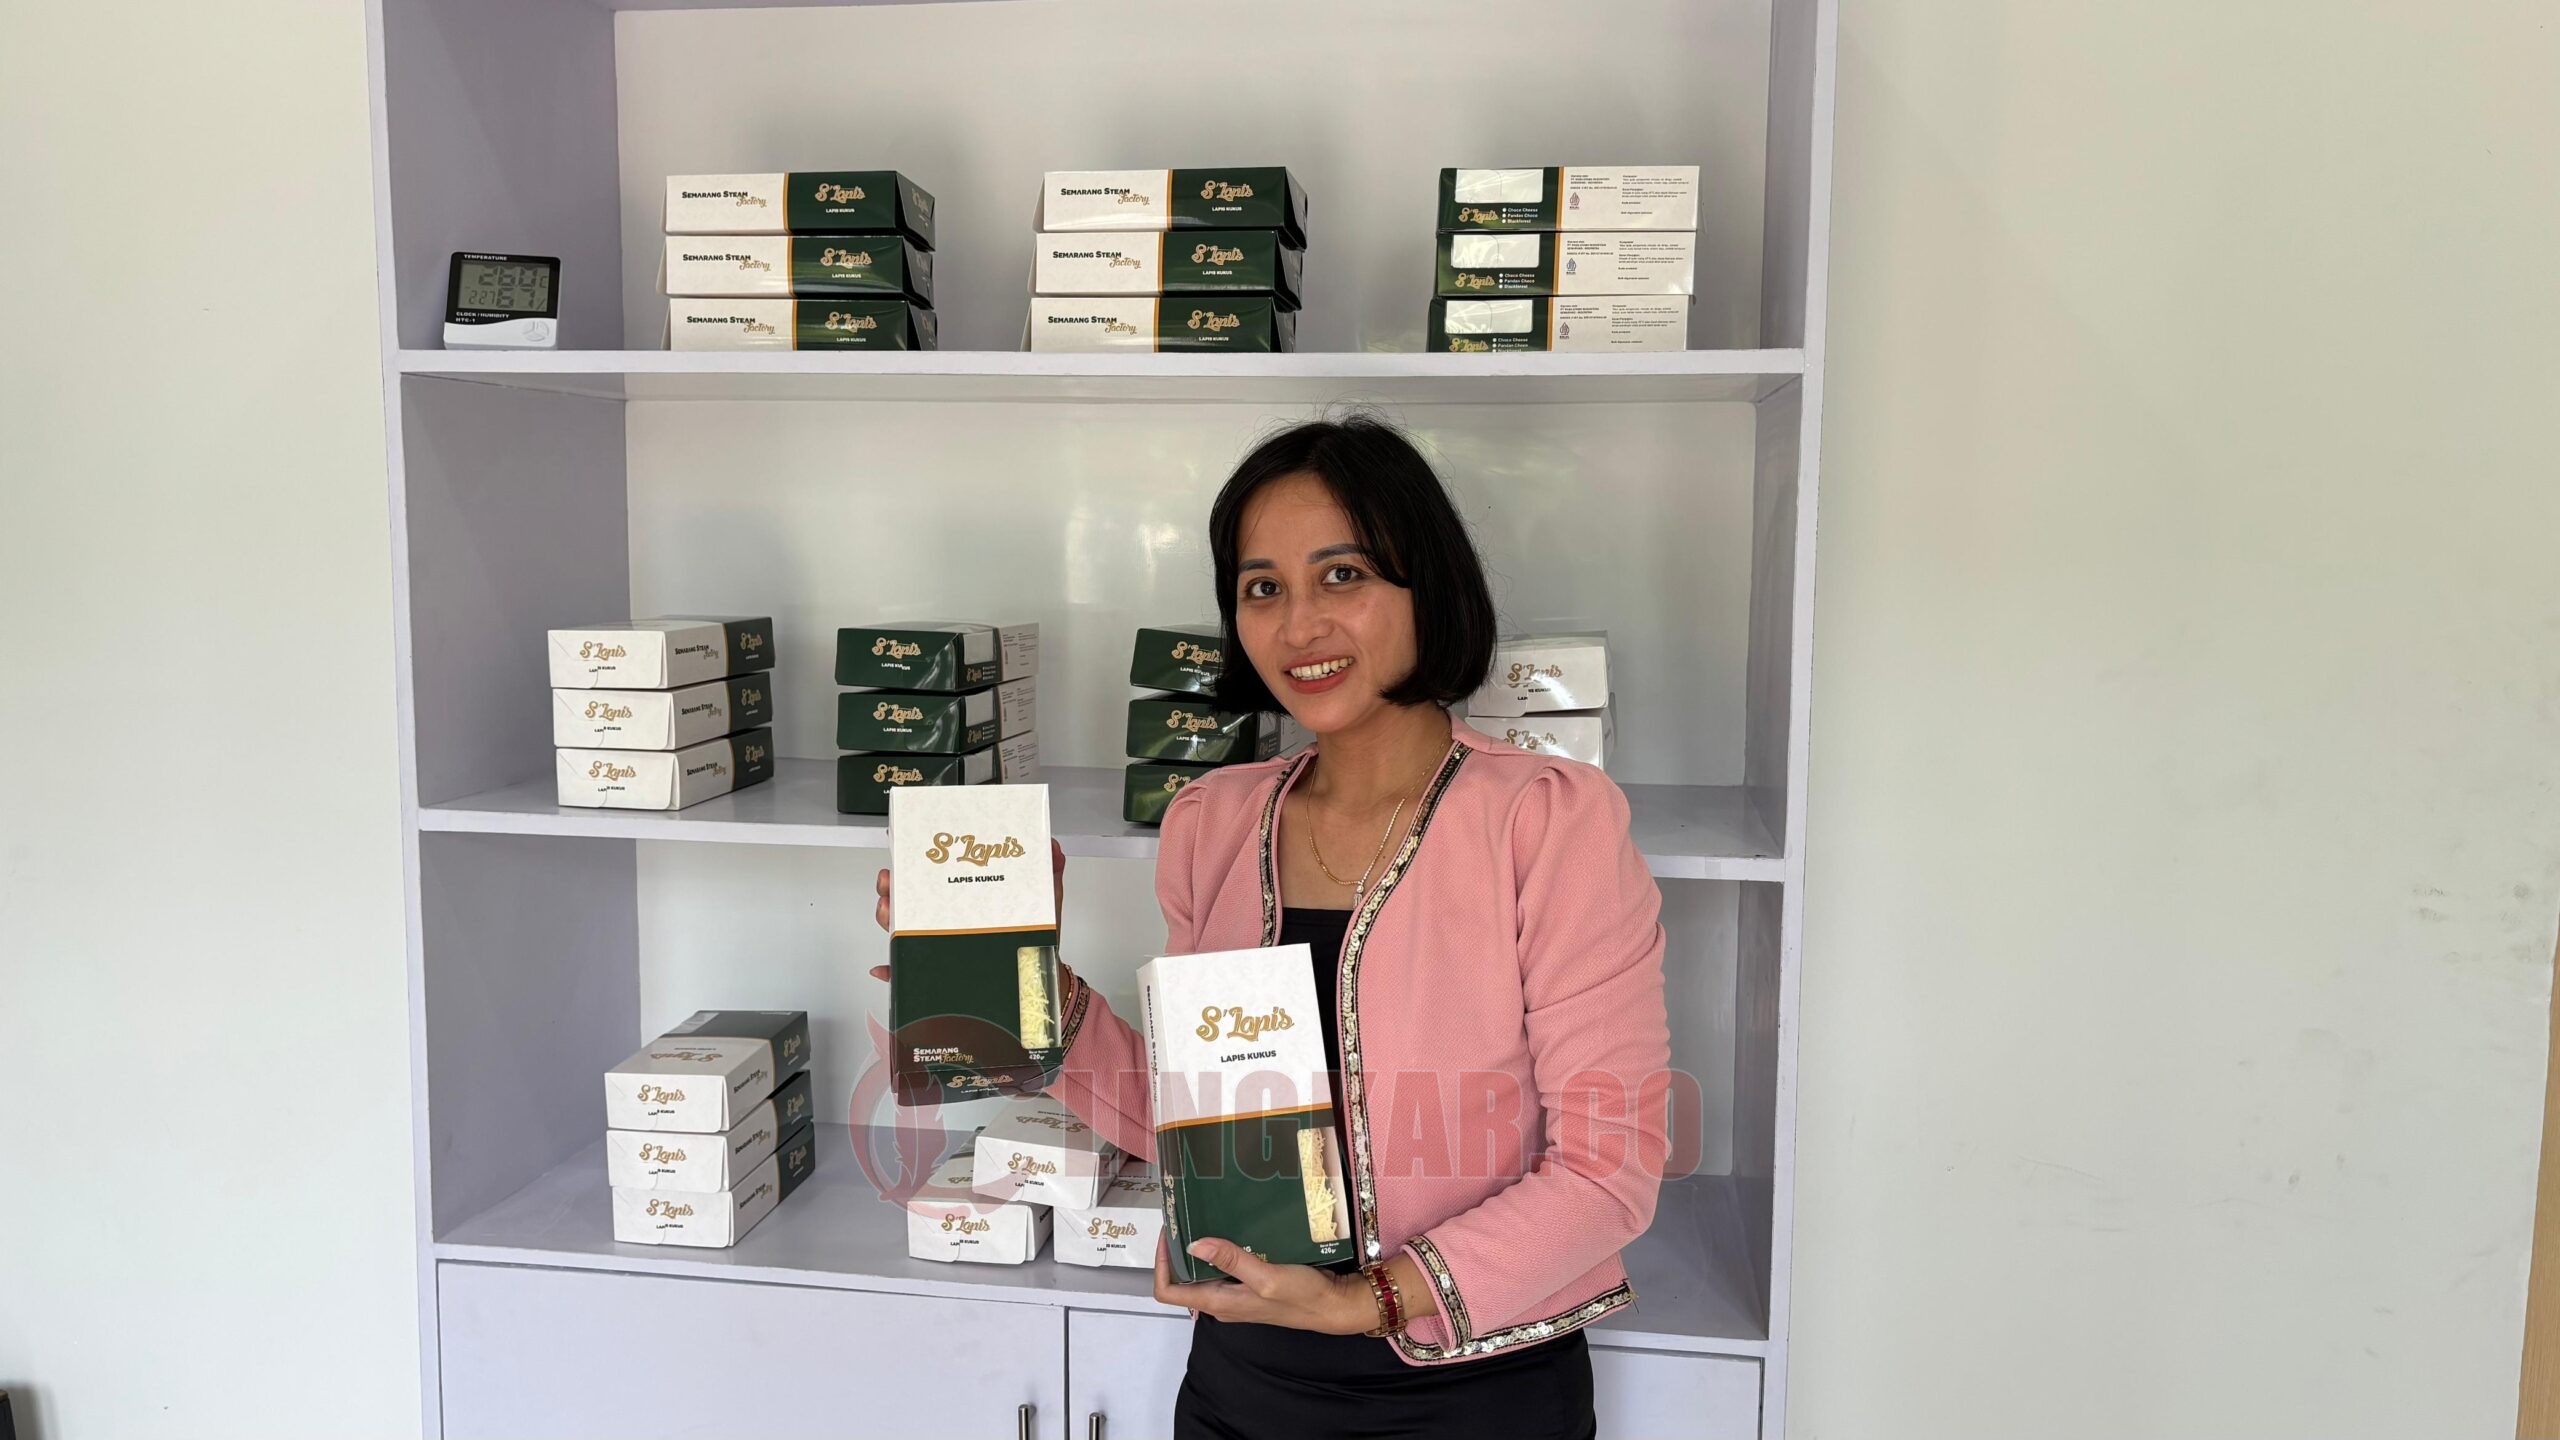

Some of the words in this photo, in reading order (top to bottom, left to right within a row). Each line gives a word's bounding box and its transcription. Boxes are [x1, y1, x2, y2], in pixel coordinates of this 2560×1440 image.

[682, 191, 721, 199] SEMARANG
[723, 190, 748, 198] STEAM
[1061, 188, 1102, 196] SEMARANG
[1104, 187, 1130, 195] STEAM
[725, 253, 751, 261] STEAM
[1053, 251, 1094, 259] SEMARANG
[1095, 250, 1122, 258] STEAM
[687, 316, 728, 324] SEMARANG
[730, 315, 756, 323] STEAM
[1048, 316, 1089, 324] SEMARANG
[925, 831, 1026, 867] S'Lapis
[947, 876, 974, 884] LAPIS
[975, 875, 1005, 883] KUKUS
[1196, 1005, 1295, 1042] S'Lapis
[914, 1047, 959, 1055] SEMARANG
[1220, 1053, 1246, 1064] LAPIS
[1247, 1050, 1277, 1061] KUKUS
